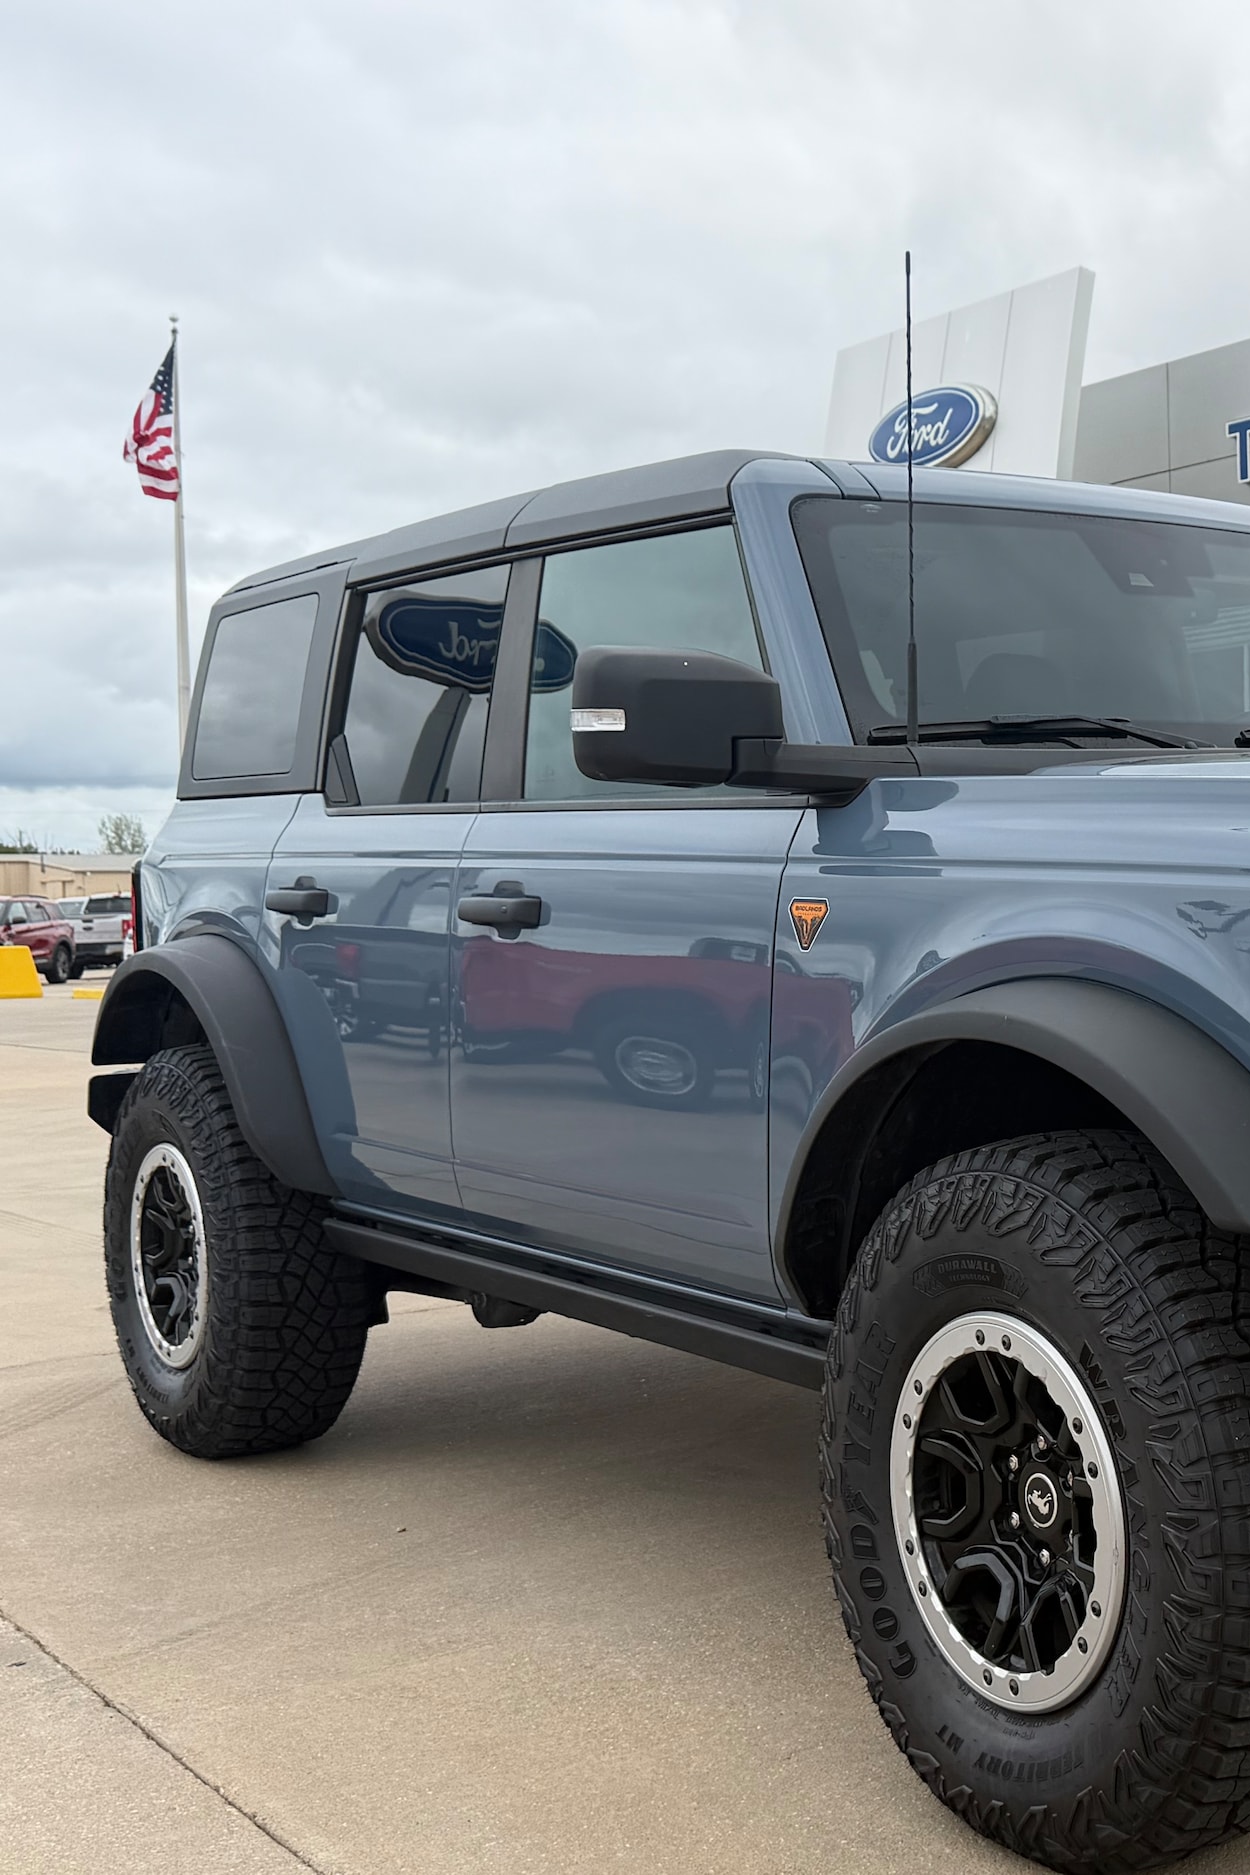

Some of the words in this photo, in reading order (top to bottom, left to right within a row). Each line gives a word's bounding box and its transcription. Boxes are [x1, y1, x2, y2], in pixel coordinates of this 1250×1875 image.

[886, 402, 954, 459] Ford
[938, 1260, 997, 1274] DURAWALL
[1080, 1339, 1152, 1719] WRANGLER
[934, 1723, 965, 1756] MT
